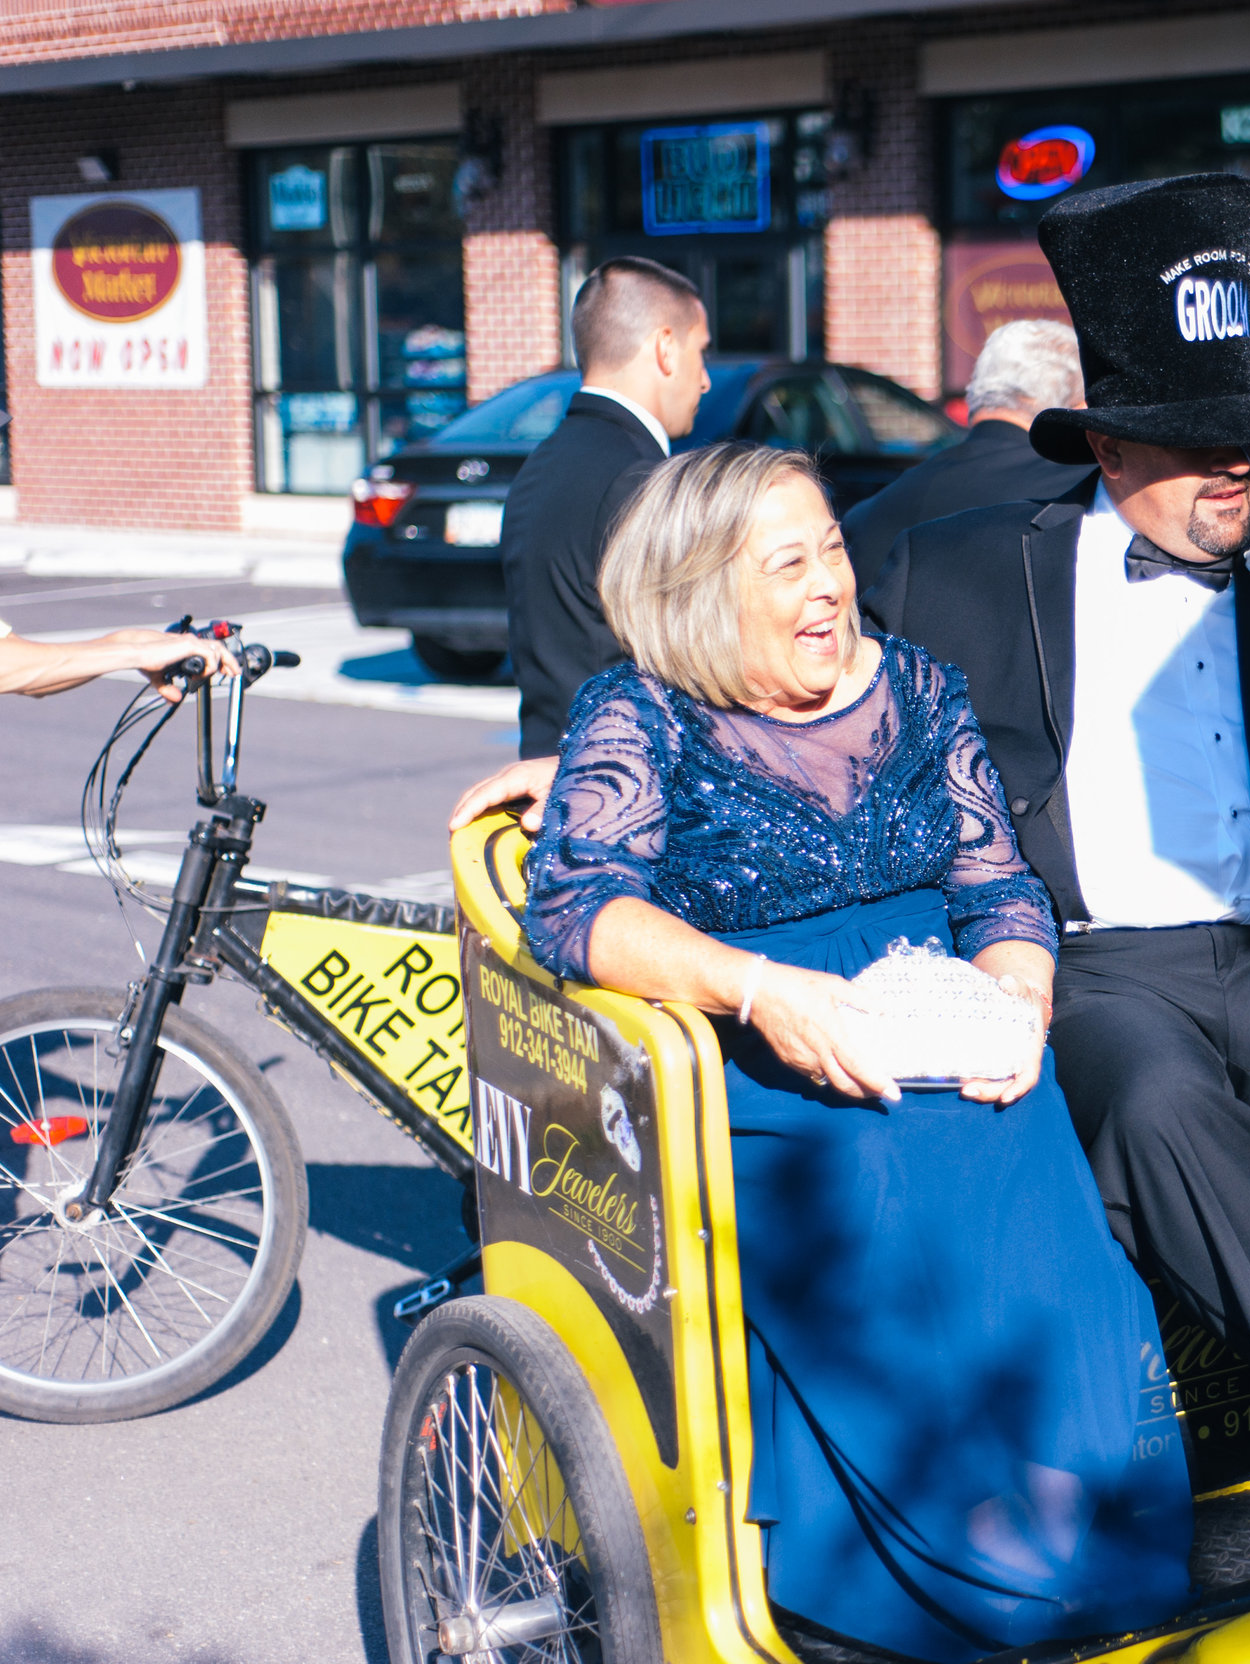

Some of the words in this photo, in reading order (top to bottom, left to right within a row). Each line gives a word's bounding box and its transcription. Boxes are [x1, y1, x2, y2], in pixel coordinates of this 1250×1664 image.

[1159, 257, 1193, 285] MAKE
[1193, 249, 1228, 266] ROOM
[50, 337, 106, 372] NOW
[120, 335, 190, 372] OPEN
[300, 949, 415, 1057] BIKE
[479, 963, 529, 1023] ROYAL
[528, 991, 565, 1043] BIKE
[564, 1011, 600, 1064] TAXI
[498, 1012, 588, 1095] 912-341-3944
[530, 1123, 639, 1236] Jewelers
[561, 1203, 593, 1232] SINCE
[1150, 1377, 1241, 1414] SINCE
